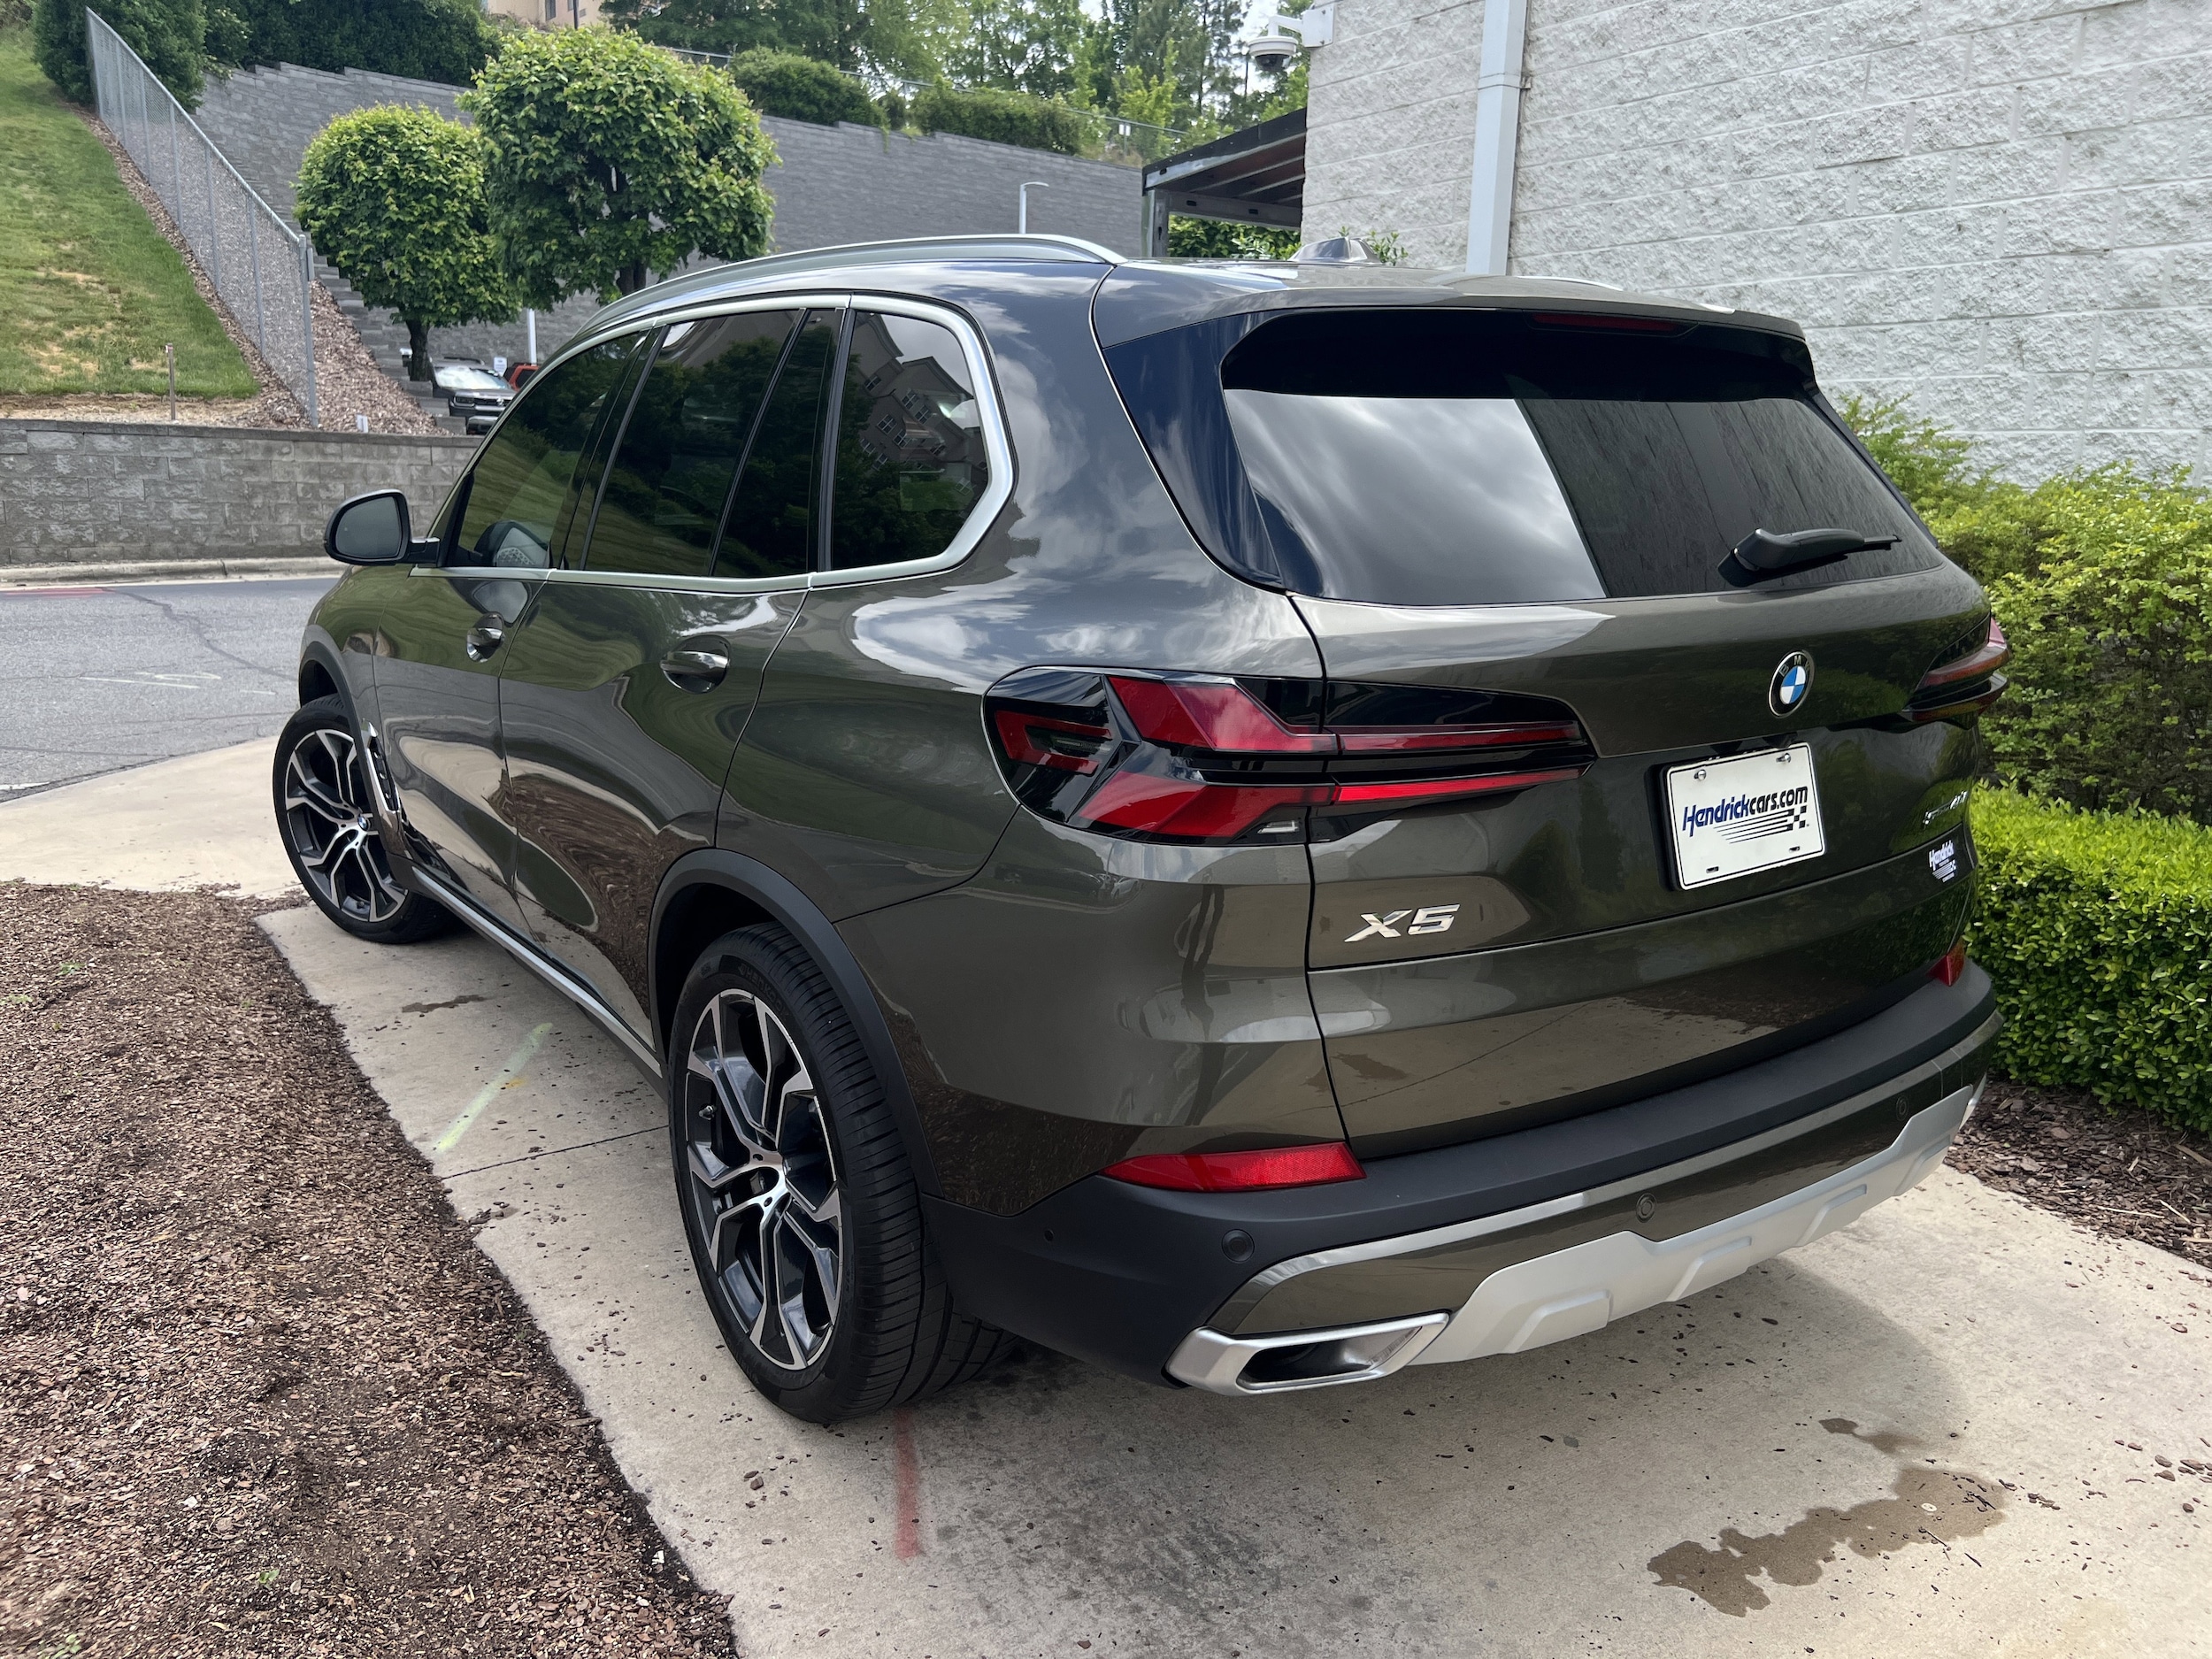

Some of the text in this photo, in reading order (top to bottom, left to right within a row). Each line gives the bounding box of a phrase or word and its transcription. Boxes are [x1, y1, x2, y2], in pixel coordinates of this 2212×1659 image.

[1778, 655, 1811, 678] BMW
[1682, 786, 1809, 838] Hendrickcars.com
[1344, 903, 1461, 943] X5
